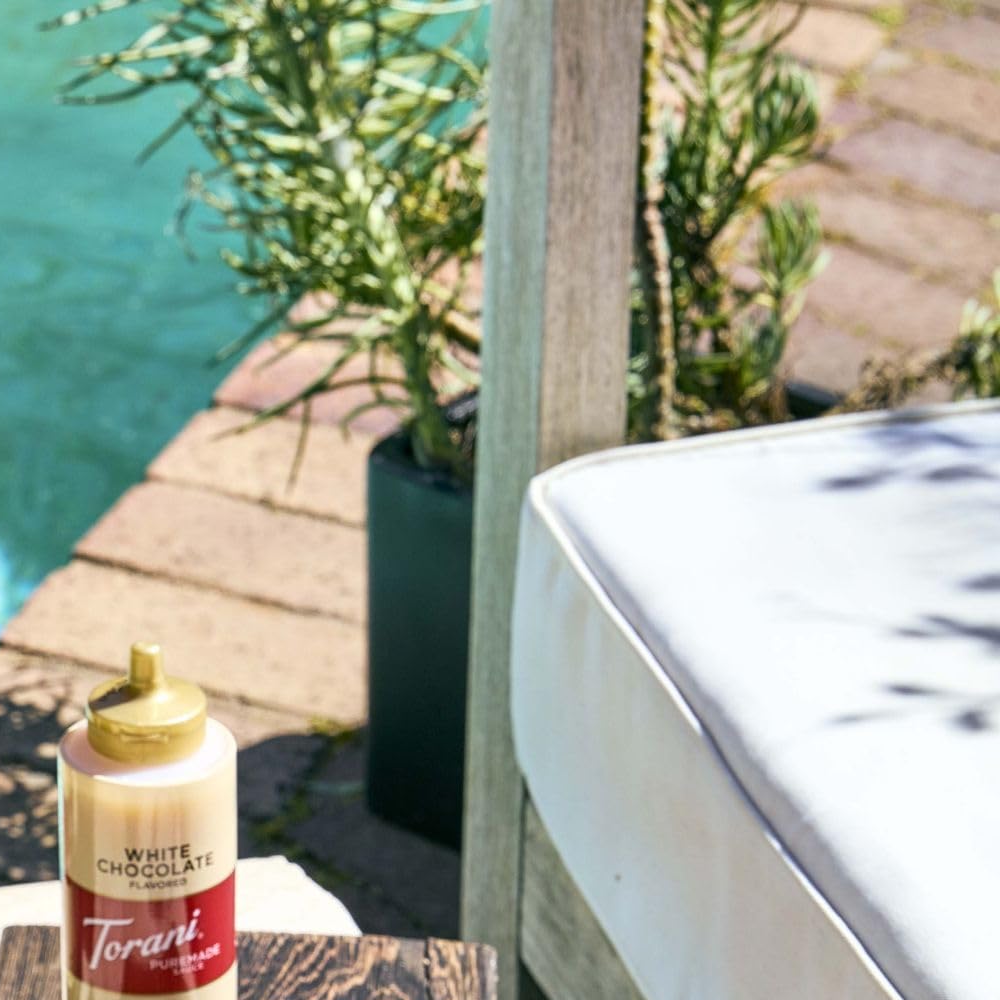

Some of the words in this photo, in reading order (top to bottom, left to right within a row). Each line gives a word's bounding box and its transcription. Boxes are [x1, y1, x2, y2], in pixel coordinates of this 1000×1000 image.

[124, 843, 191, 862] WHITE
[96, 851, 214, 878] CHOCOLATE
[128, 877, 188, 890] FLAVORED
[82, 908, 201, 970] Torani
